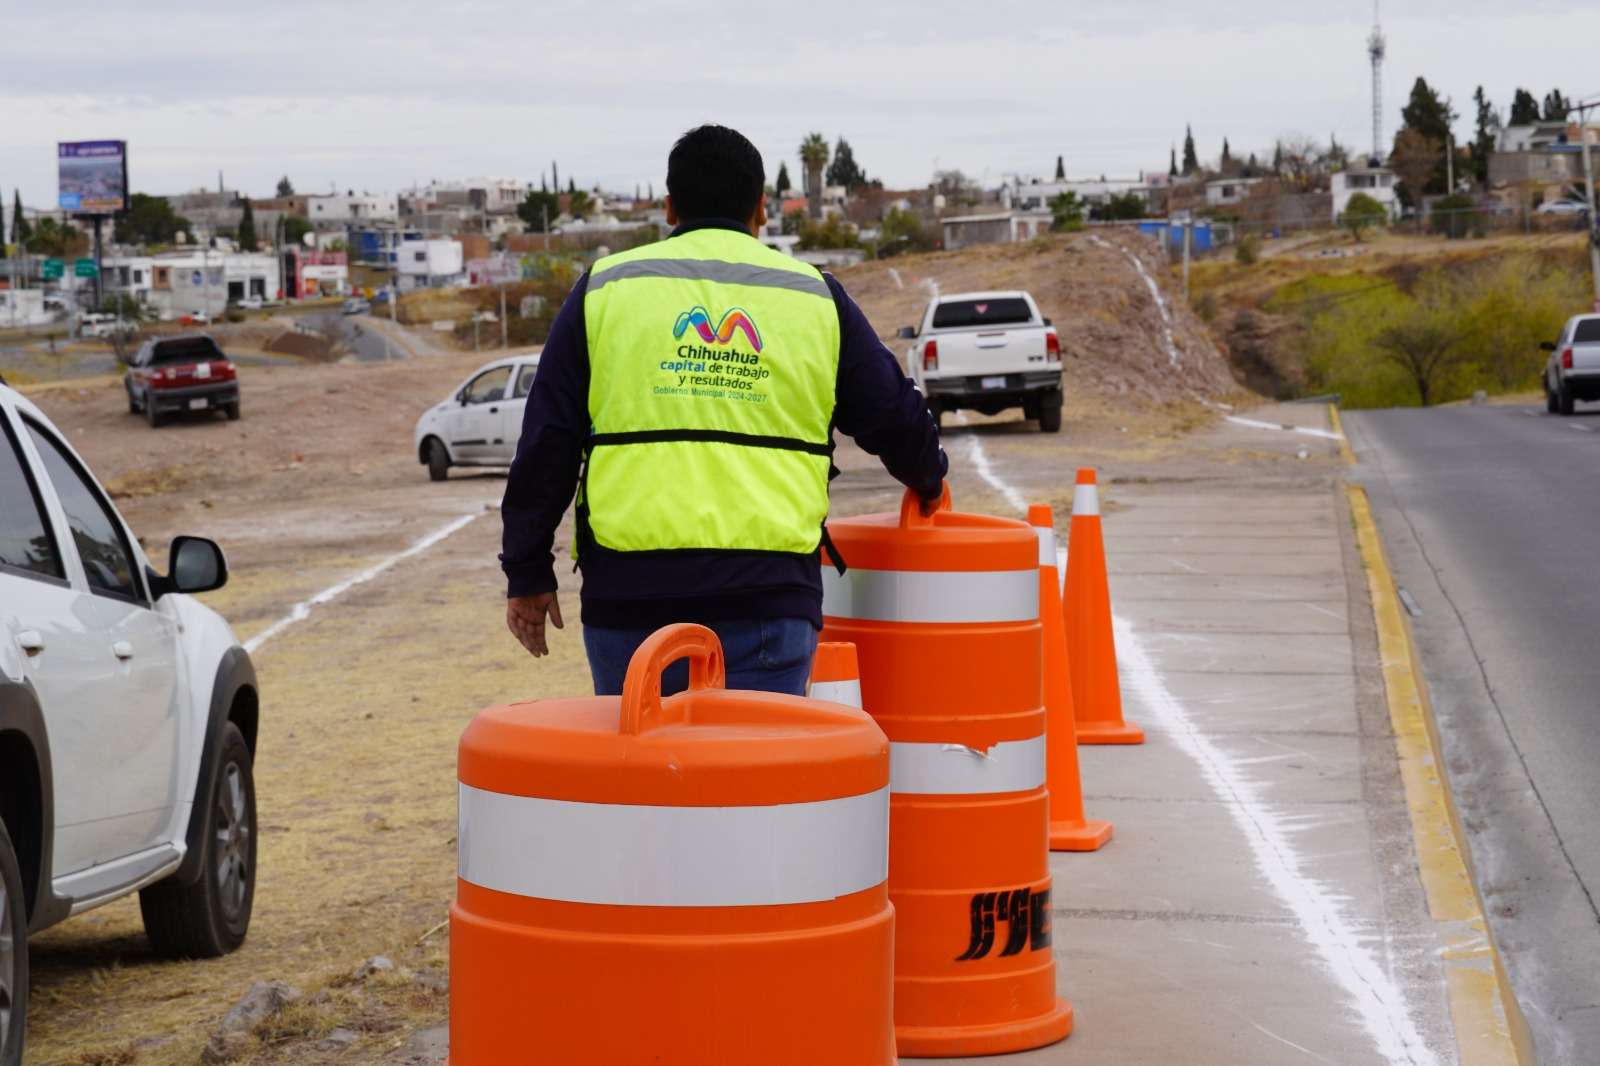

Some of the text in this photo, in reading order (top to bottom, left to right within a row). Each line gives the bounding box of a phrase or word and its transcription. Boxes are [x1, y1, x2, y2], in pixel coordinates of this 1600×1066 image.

[677, 345, 759, 365] Chihuahua
[660, 360, 770, 380] capital de trabajo
[678, 375, 753, 390] y resultados
[653, 385, 689, 395] Gobierno
[691, 388, 725, 398] Municipal
